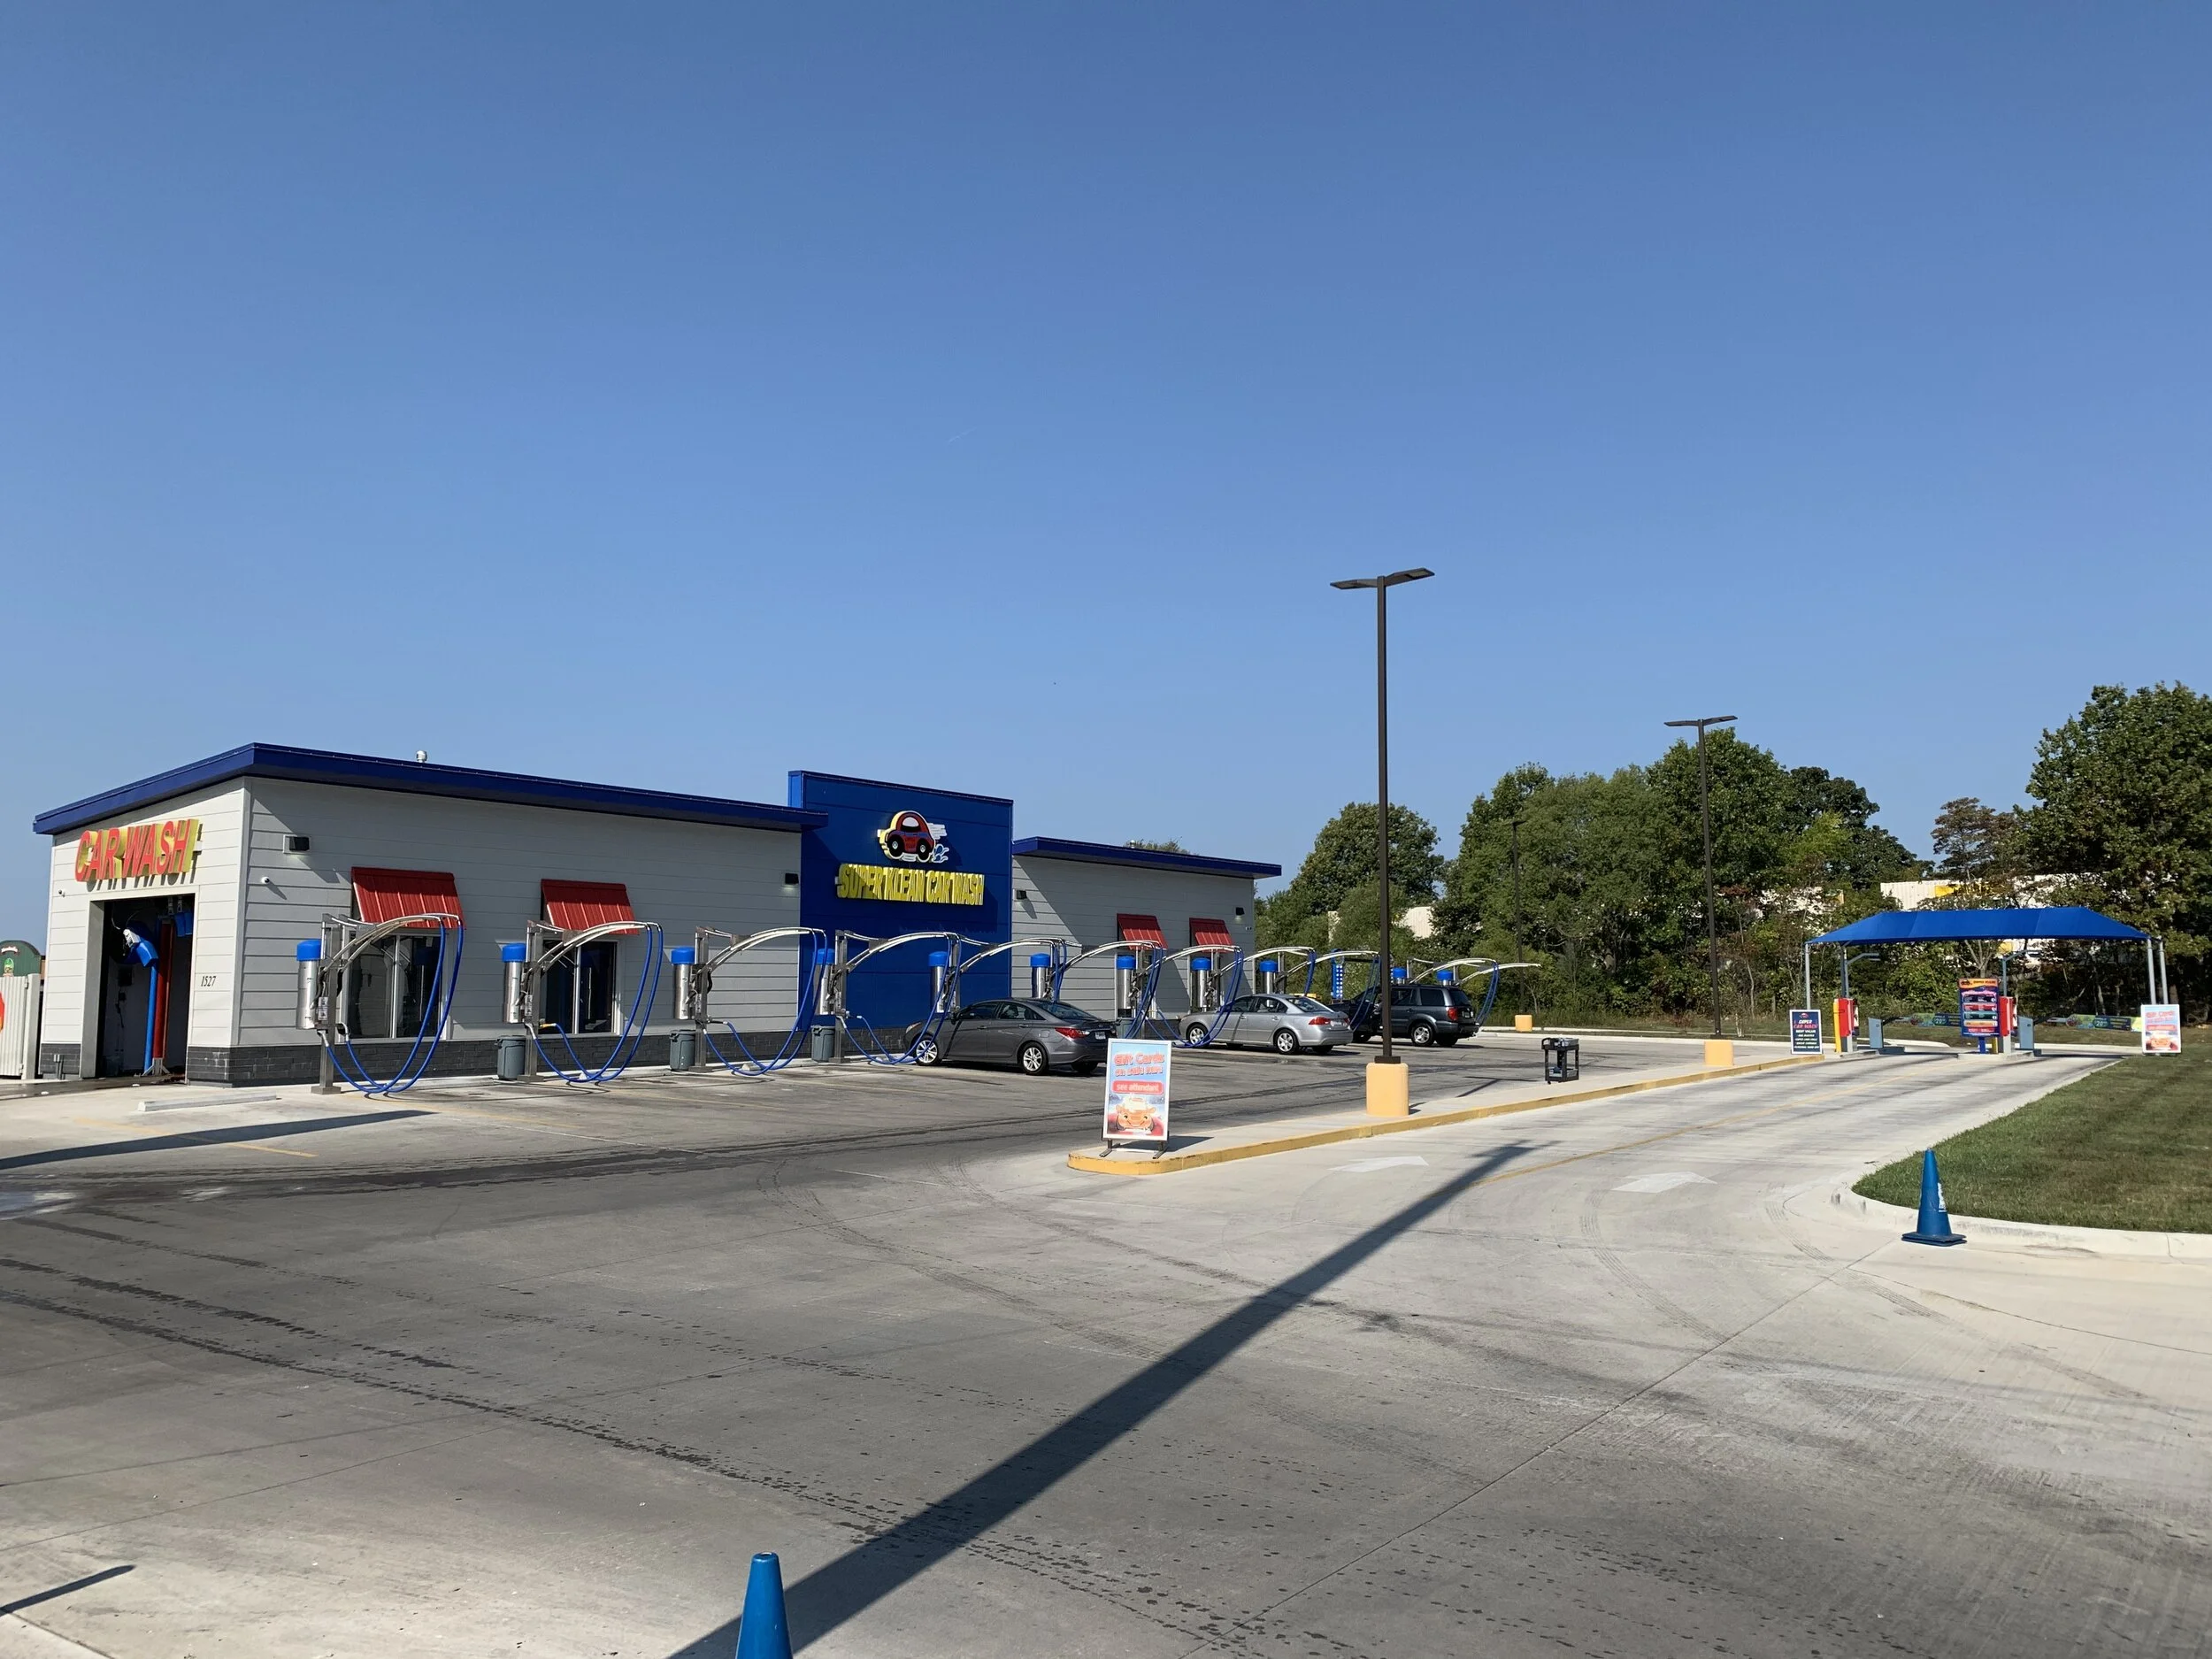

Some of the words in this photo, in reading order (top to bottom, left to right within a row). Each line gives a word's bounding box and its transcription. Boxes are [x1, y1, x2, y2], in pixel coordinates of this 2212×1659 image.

[75, 827, 123, 882] CAR
[122, 818, 198, 879] WASH
[837, 864, 884, 899] SUPER
[884, 866, 926, 902] KLEAN
[926, 870, 951, 904] CAR
[950, 872, 985, 906] WASH
[201, 975, 217, 987] 1527
[1114, 1053, 1133, 1065] Gift
[1135, 1051, 1164, 1064] Cards
[1128, 1082, 1159, 1092] attendant
